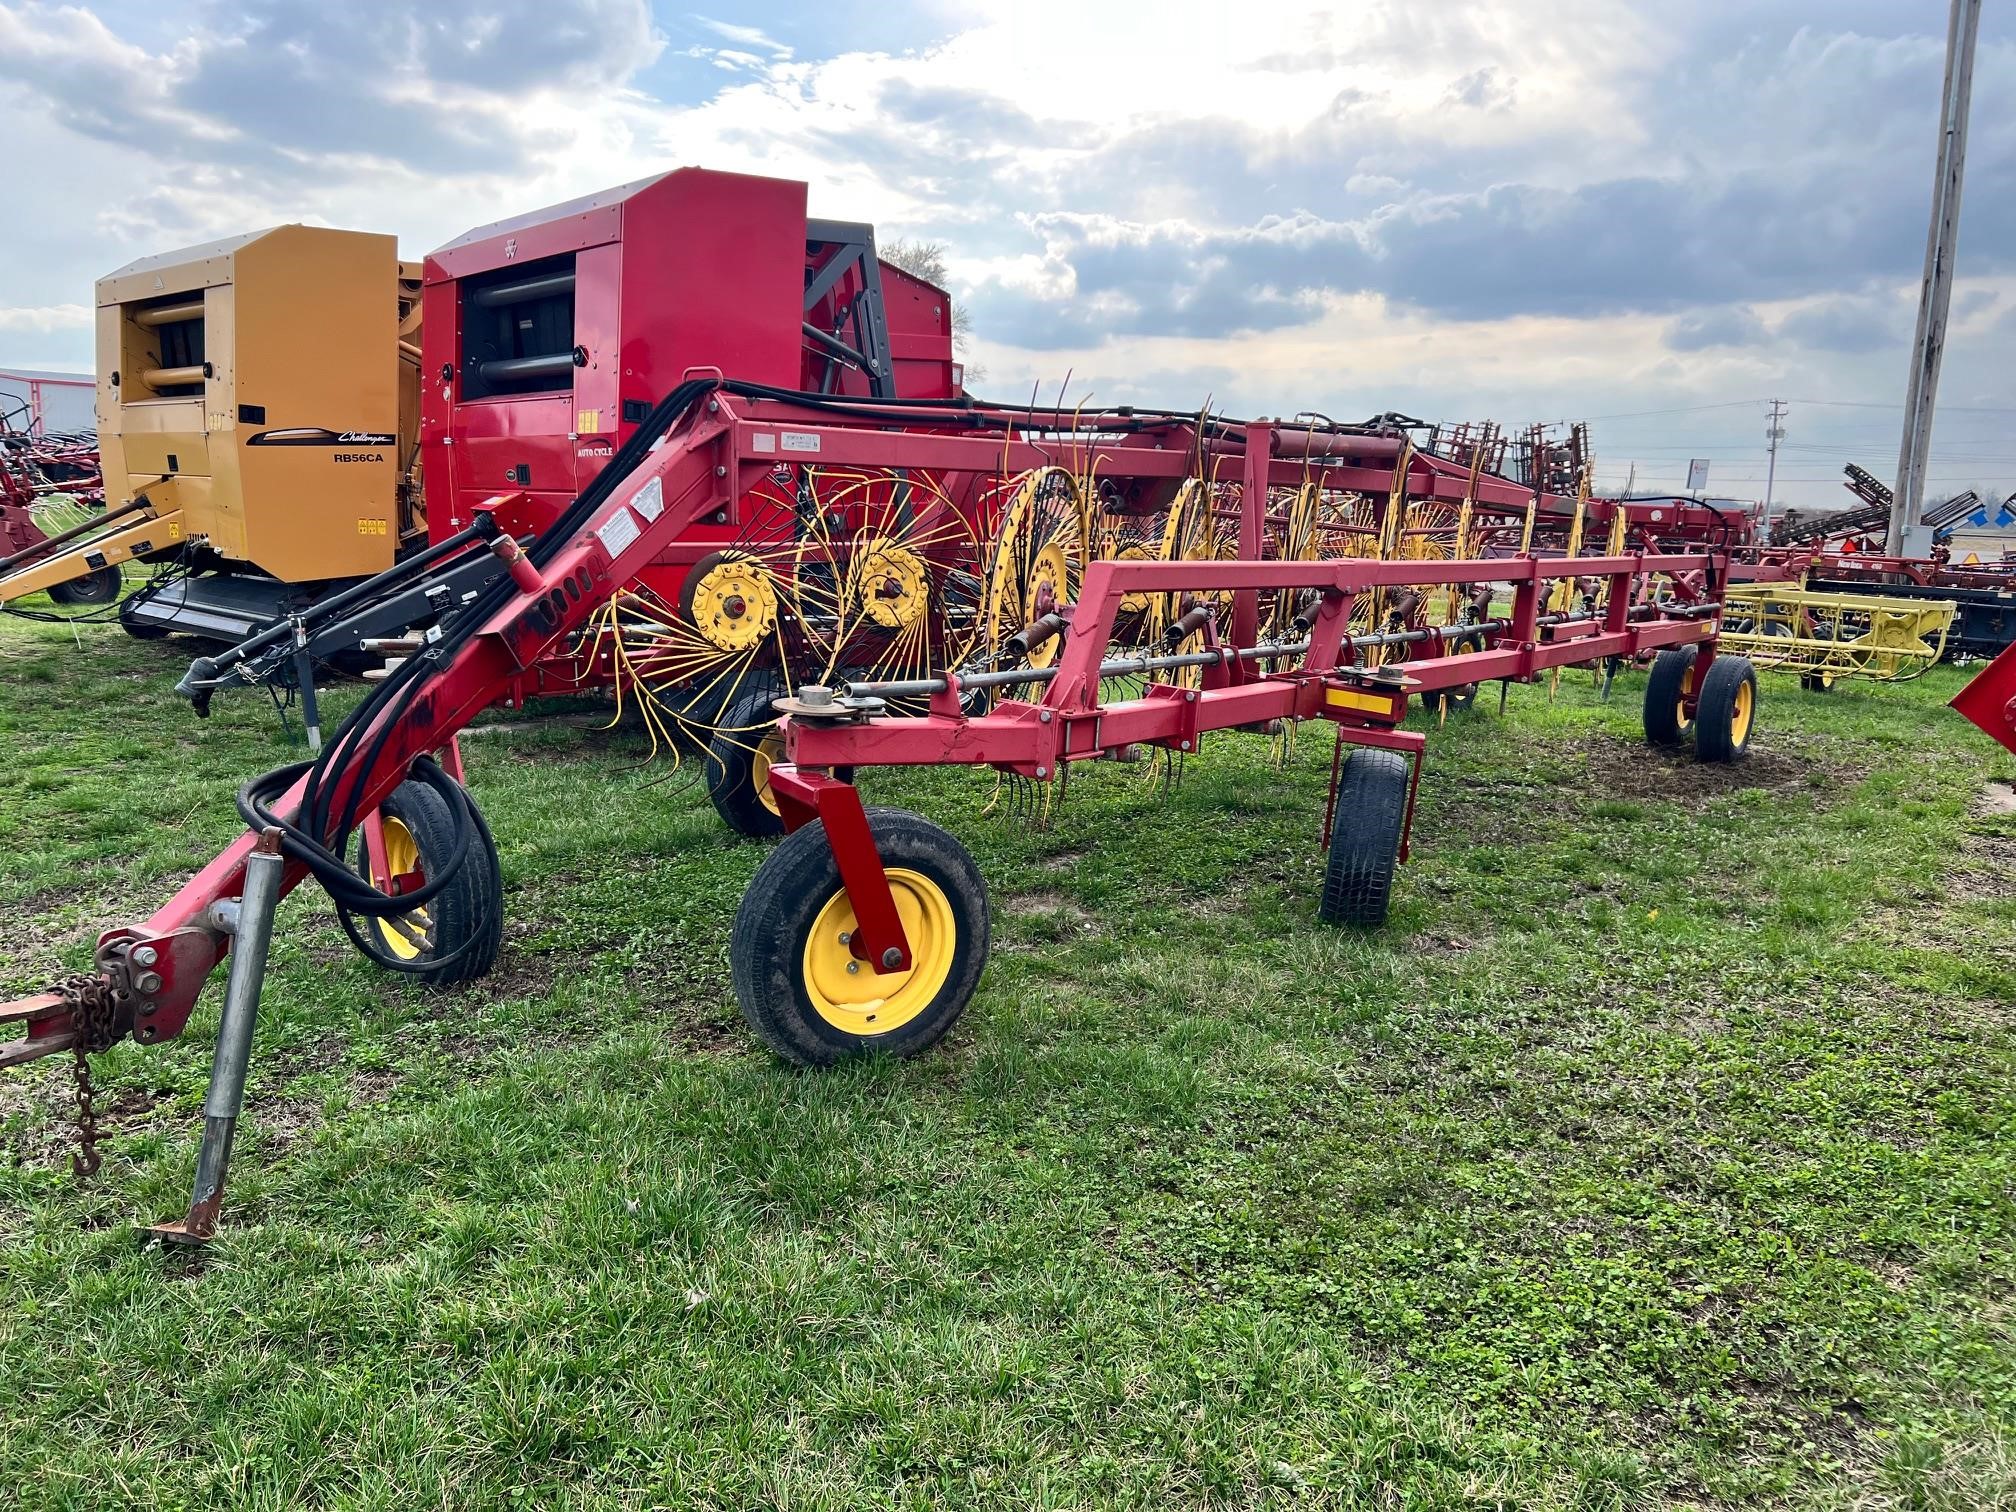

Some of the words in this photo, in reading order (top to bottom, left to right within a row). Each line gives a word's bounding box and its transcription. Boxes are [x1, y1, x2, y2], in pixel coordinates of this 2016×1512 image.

[338, 431, 392, 445] Challenger
[578, 448, 593, 457] AUTO
[594, 447, 613, 456] CYCLE
[334, 453, 384, 463] RB56CA
